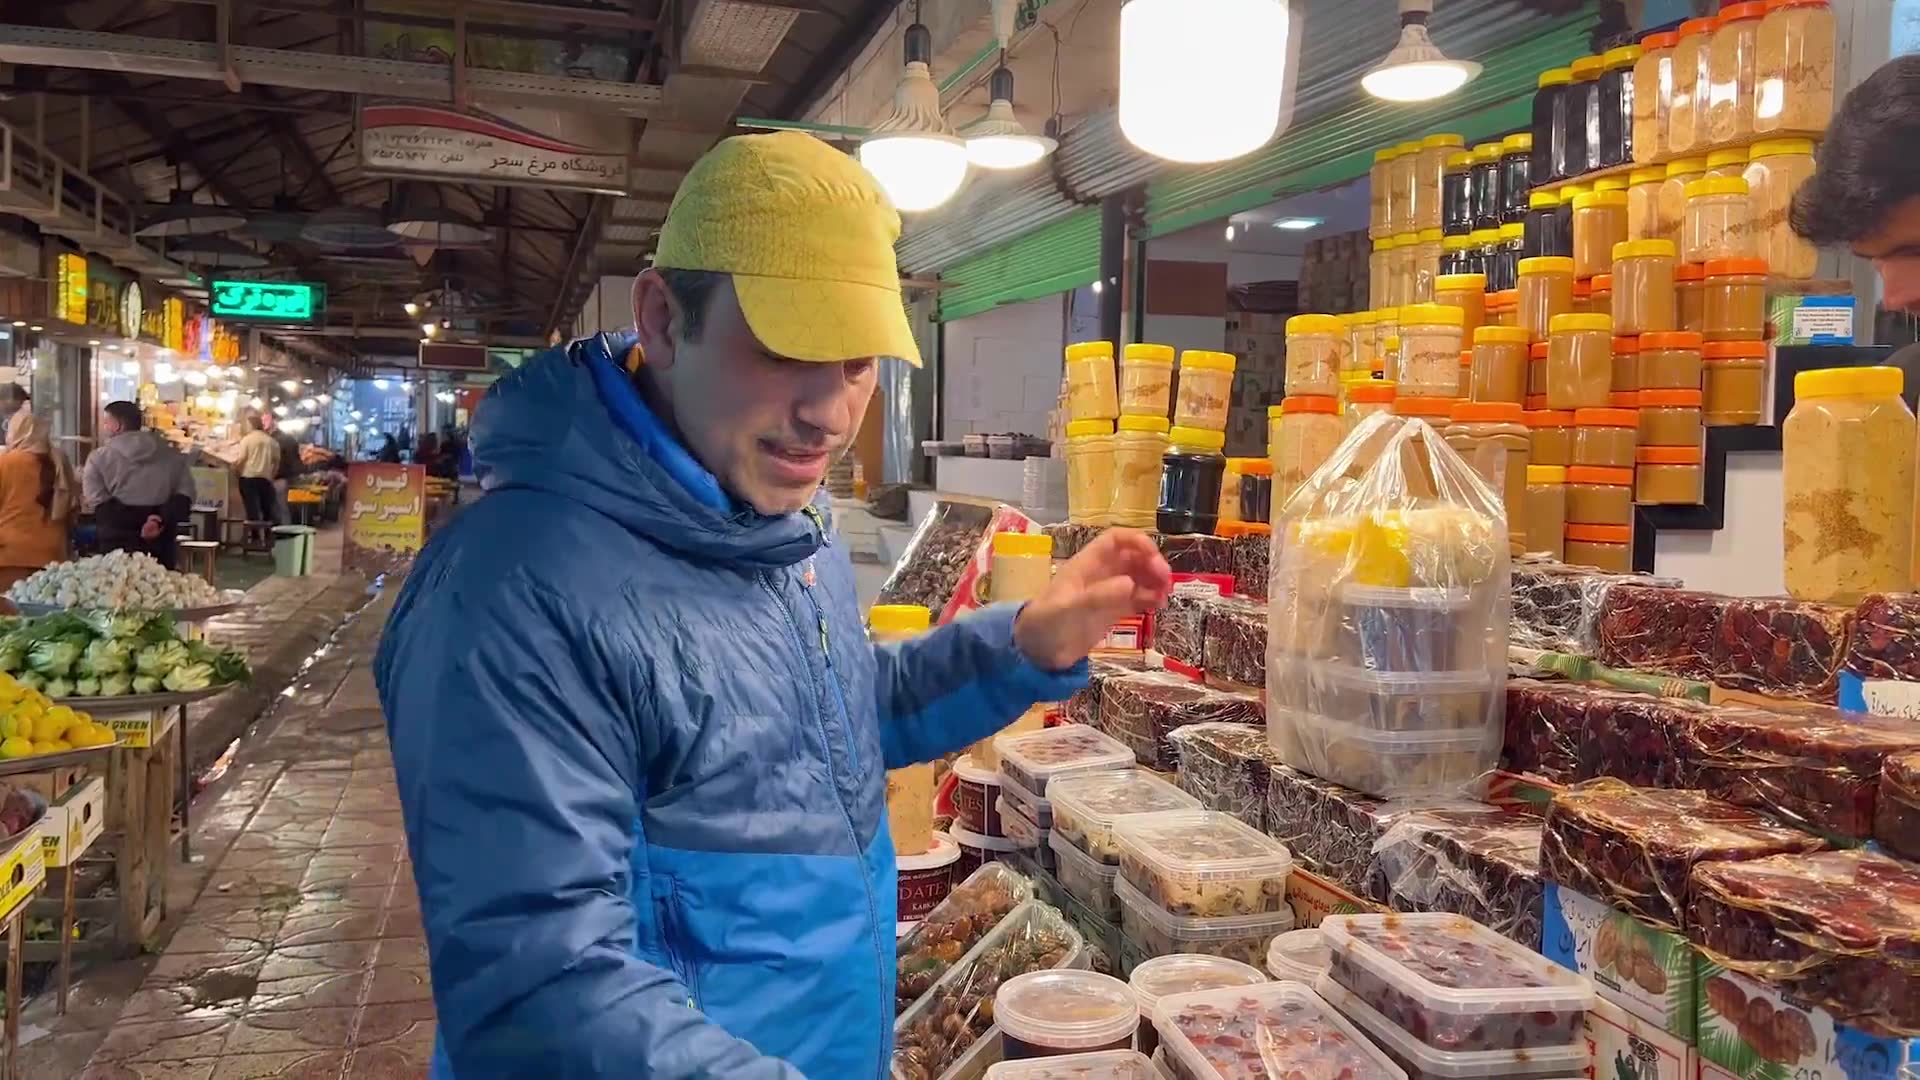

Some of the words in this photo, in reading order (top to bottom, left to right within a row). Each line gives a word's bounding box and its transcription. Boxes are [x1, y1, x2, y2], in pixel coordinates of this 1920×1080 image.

[489, 156, 523, 169] سحر
[526, 155, 557, 176] مرغ
[560, 158, 625, 178] فروشگاه
[366, 467, 408, 494] قهوه
[112, 720, 150, 729] GREEN
